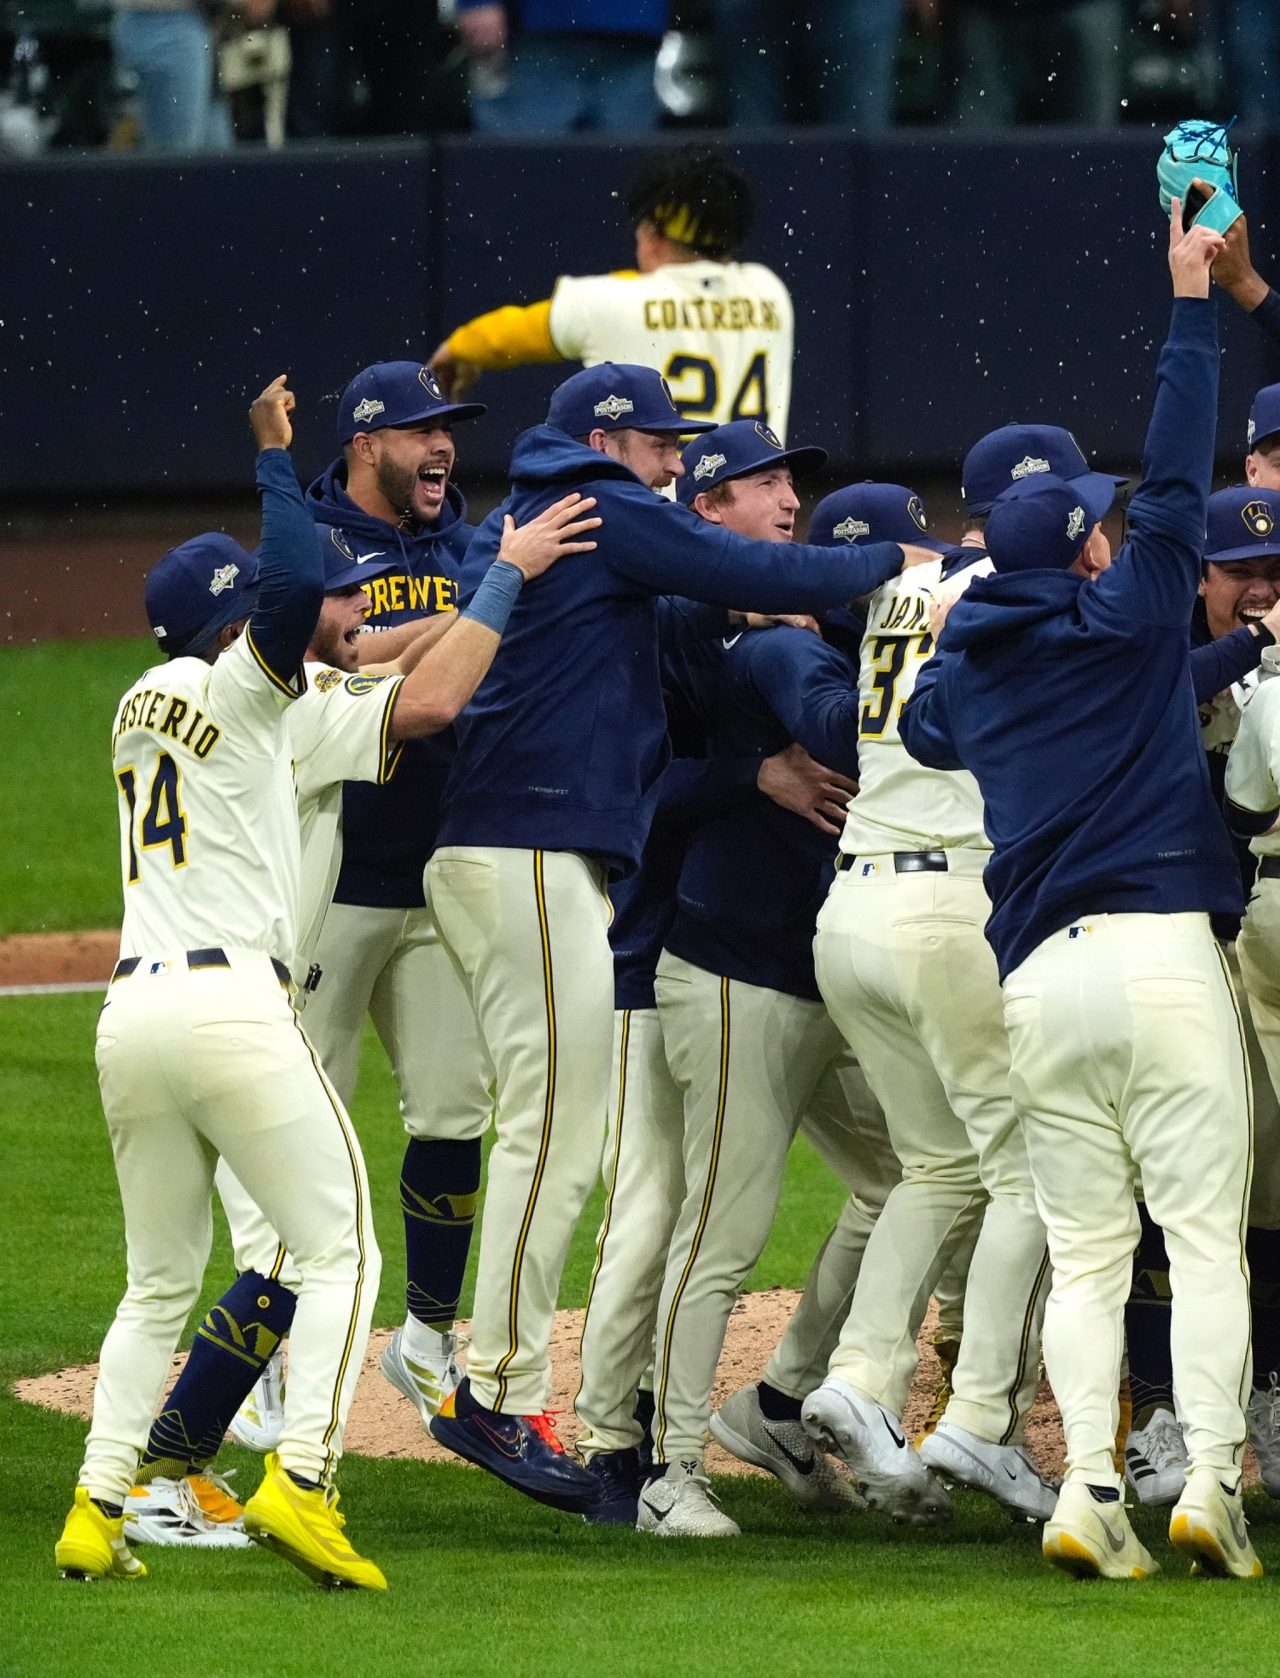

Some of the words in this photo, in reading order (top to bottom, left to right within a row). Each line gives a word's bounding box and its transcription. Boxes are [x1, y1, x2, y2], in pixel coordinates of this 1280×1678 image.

[664, 347, 770, 455] 24
[880, 596, 931, 631] JAN
[111, 690, 220, 760] ASTERIO
[116, 751, 188, 885] 14
